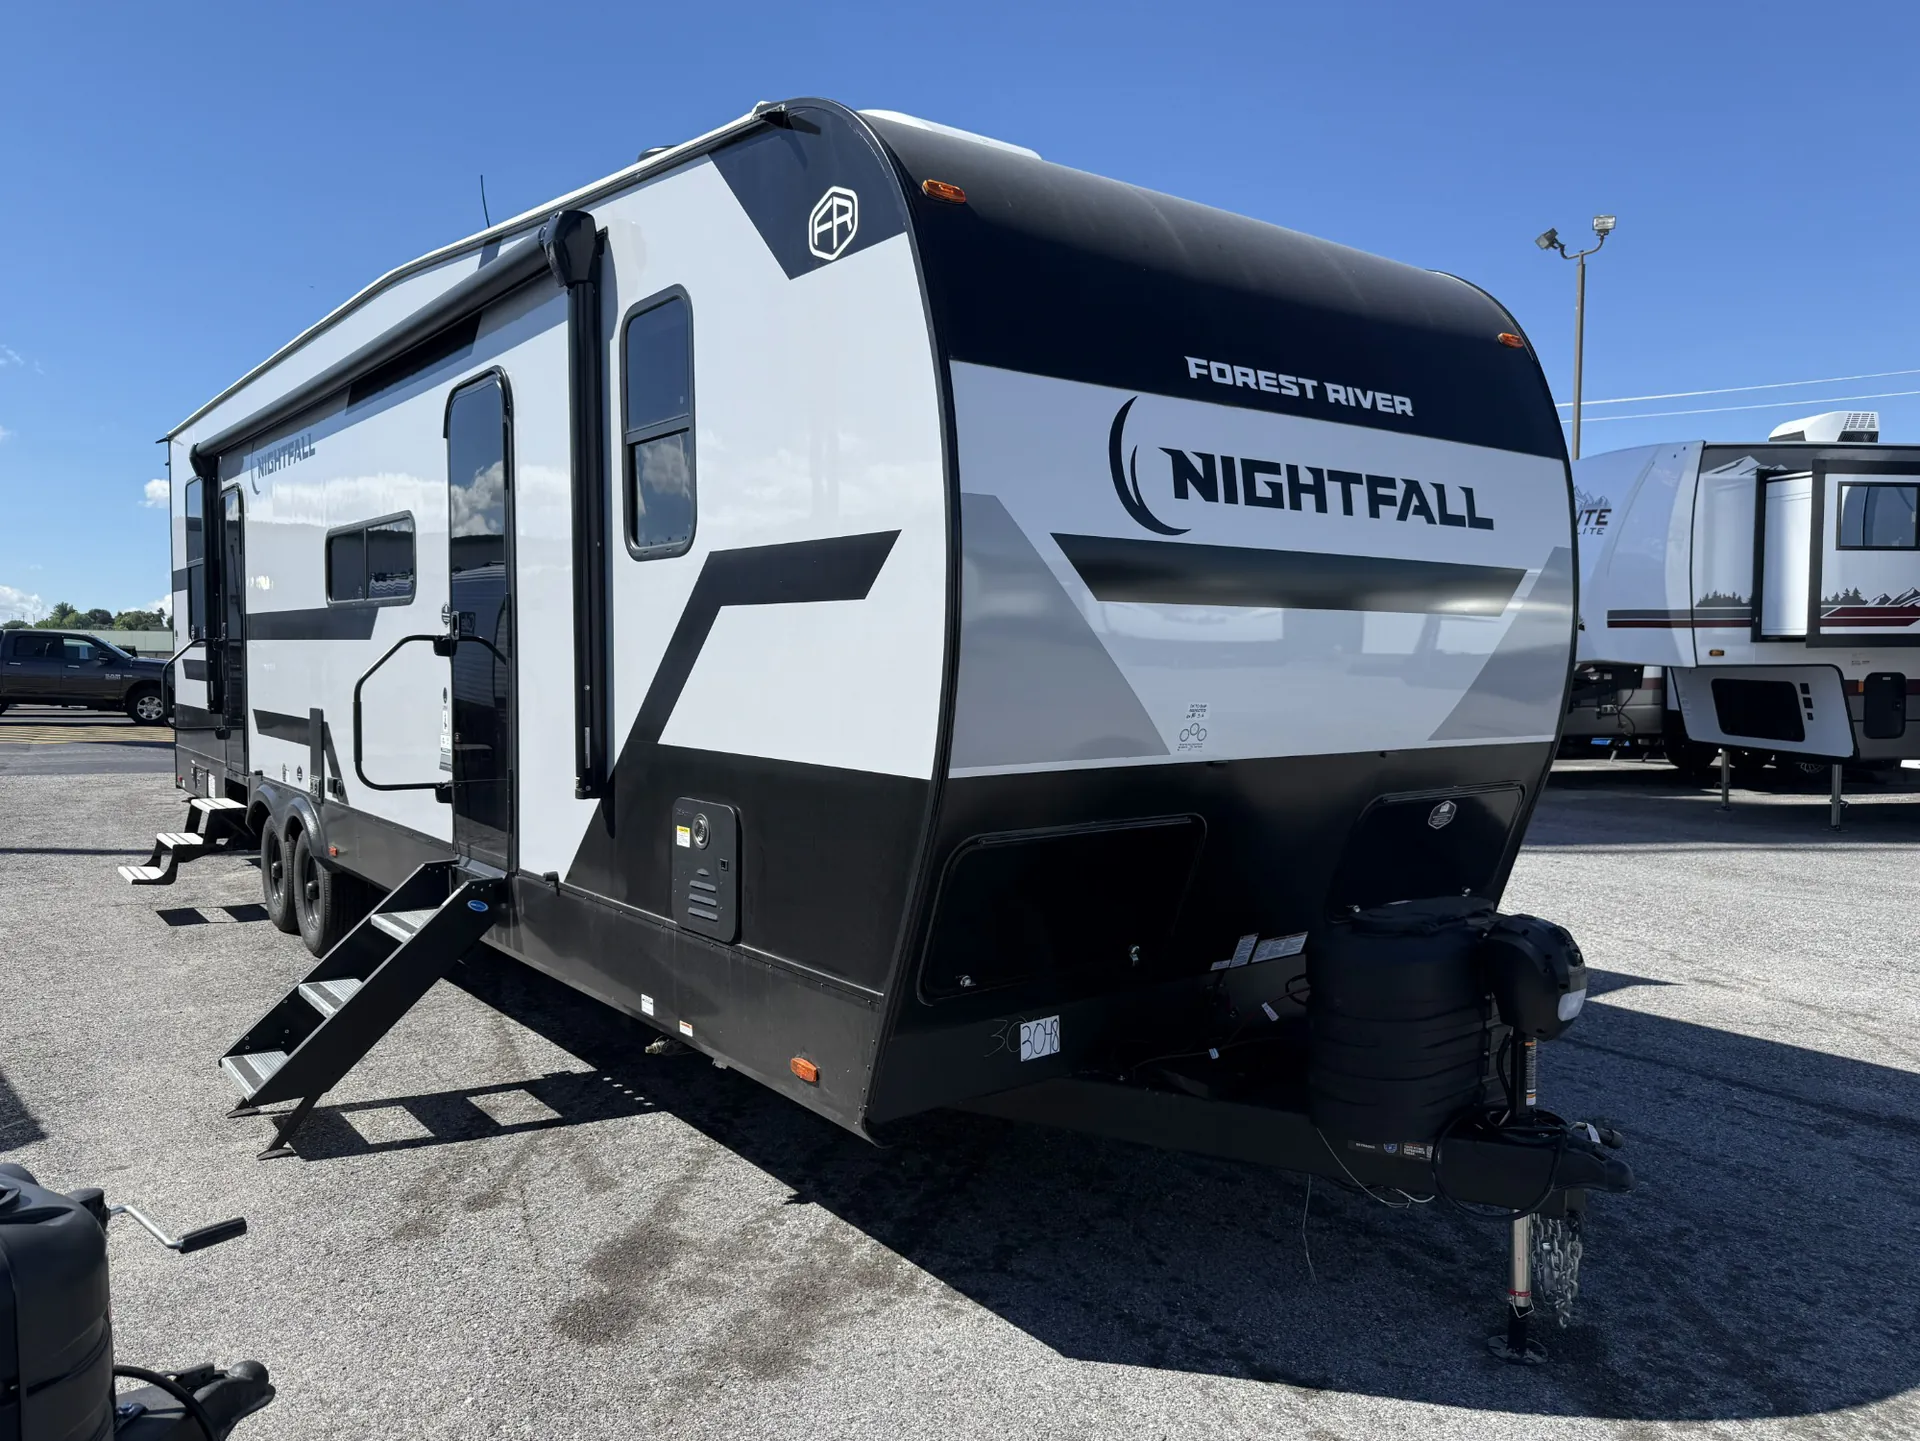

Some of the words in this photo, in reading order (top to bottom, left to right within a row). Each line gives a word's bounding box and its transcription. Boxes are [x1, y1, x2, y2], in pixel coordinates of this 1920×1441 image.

[1184, 356, 1317, 399] FOREST
[1323, 382, 1414, 416] RIVER
[257, 433, 316, 479] NIGHTFALL
[1157, 447, 1494, 530] NIGHTFALL
[1576, 508, 1612, 526] ITE
